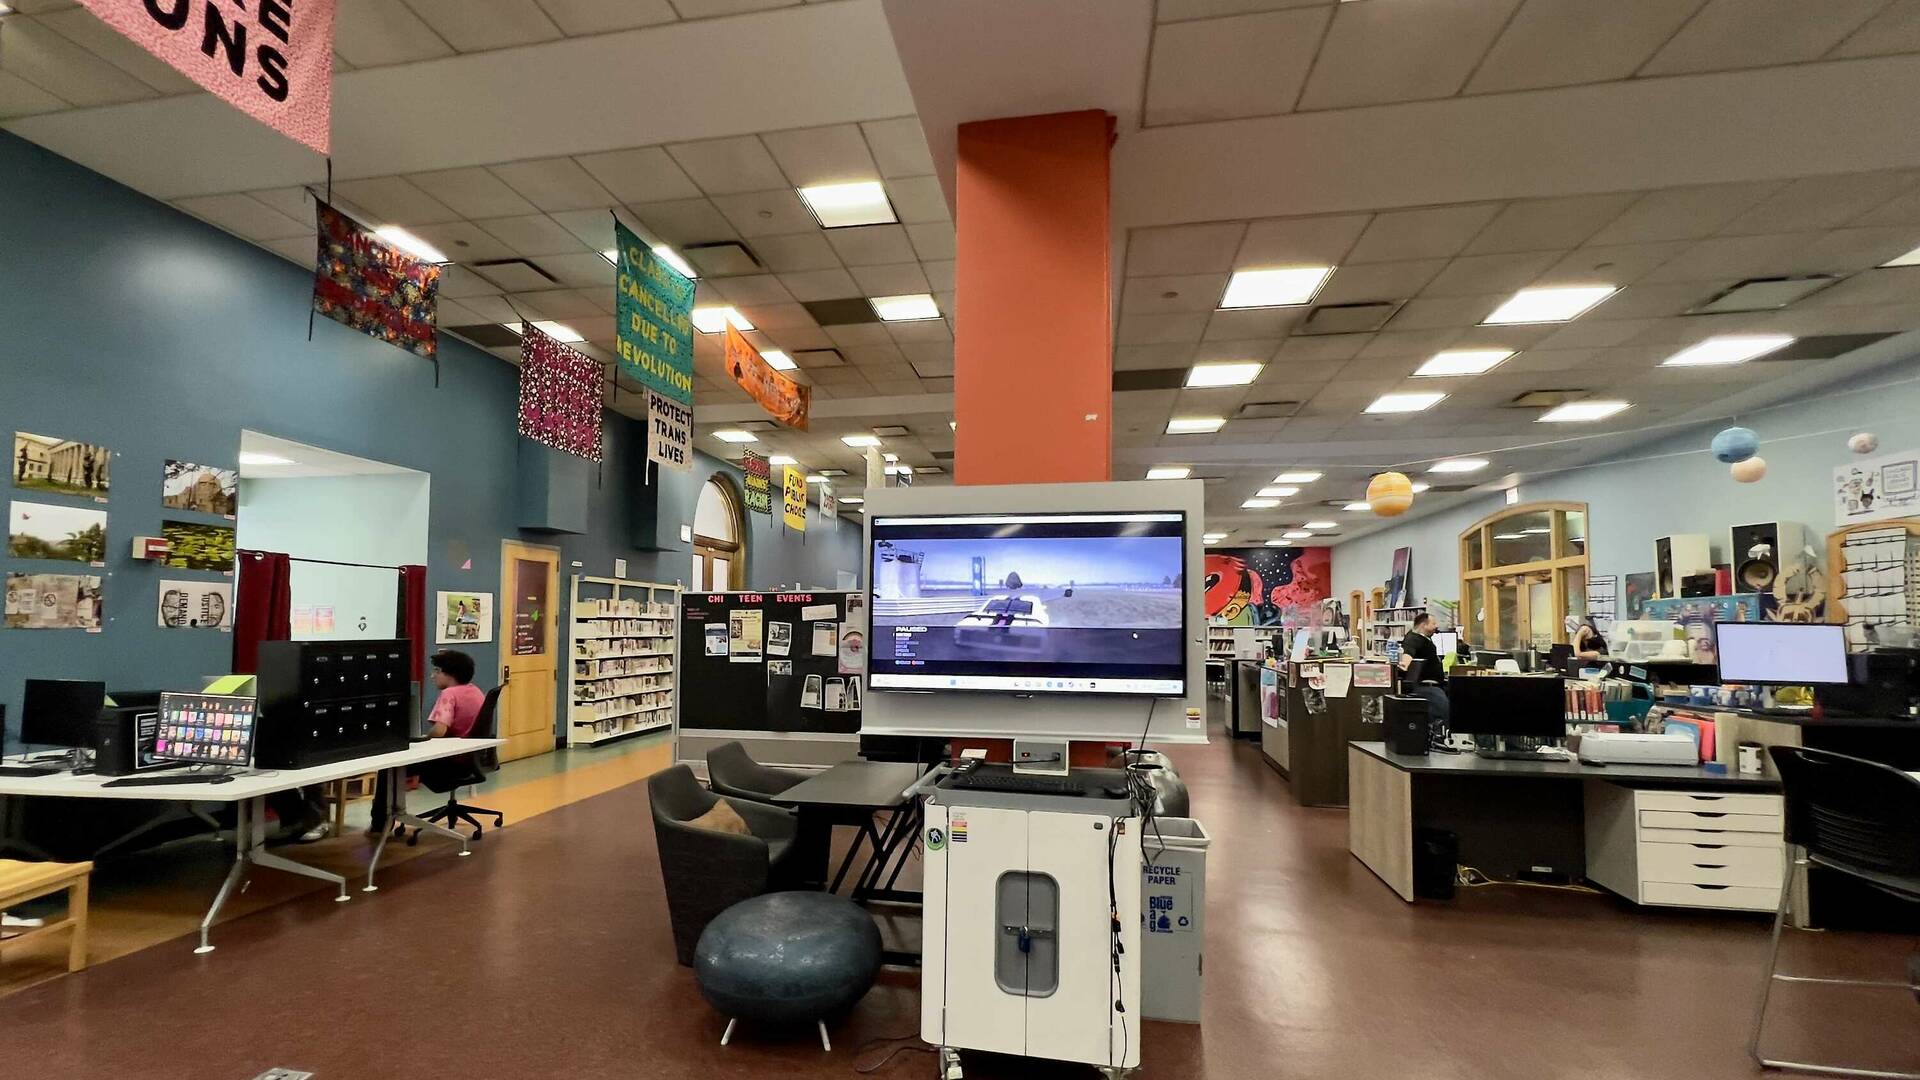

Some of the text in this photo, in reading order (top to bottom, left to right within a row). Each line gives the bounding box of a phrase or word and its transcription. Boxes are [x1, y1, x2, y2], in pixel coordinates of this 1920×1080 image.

[631, 312, 678, 355] DUE TO
[650, 394, 692, 427] PROTECT
[655, 418, 686, 445] TRANS
[658, 441, 684, 465] LIVES
[177, 592, 189, 625] DEMAND
[200, 594, 210, 625] JUSTICE
[708, 594, 812, 603] CHI TEEN EVENTS
[1143, 865, 1181, 876] RECYCLE
[1147, 875, 1176, 885] PAPER
[1149, 896, 1173, 911] Blue
